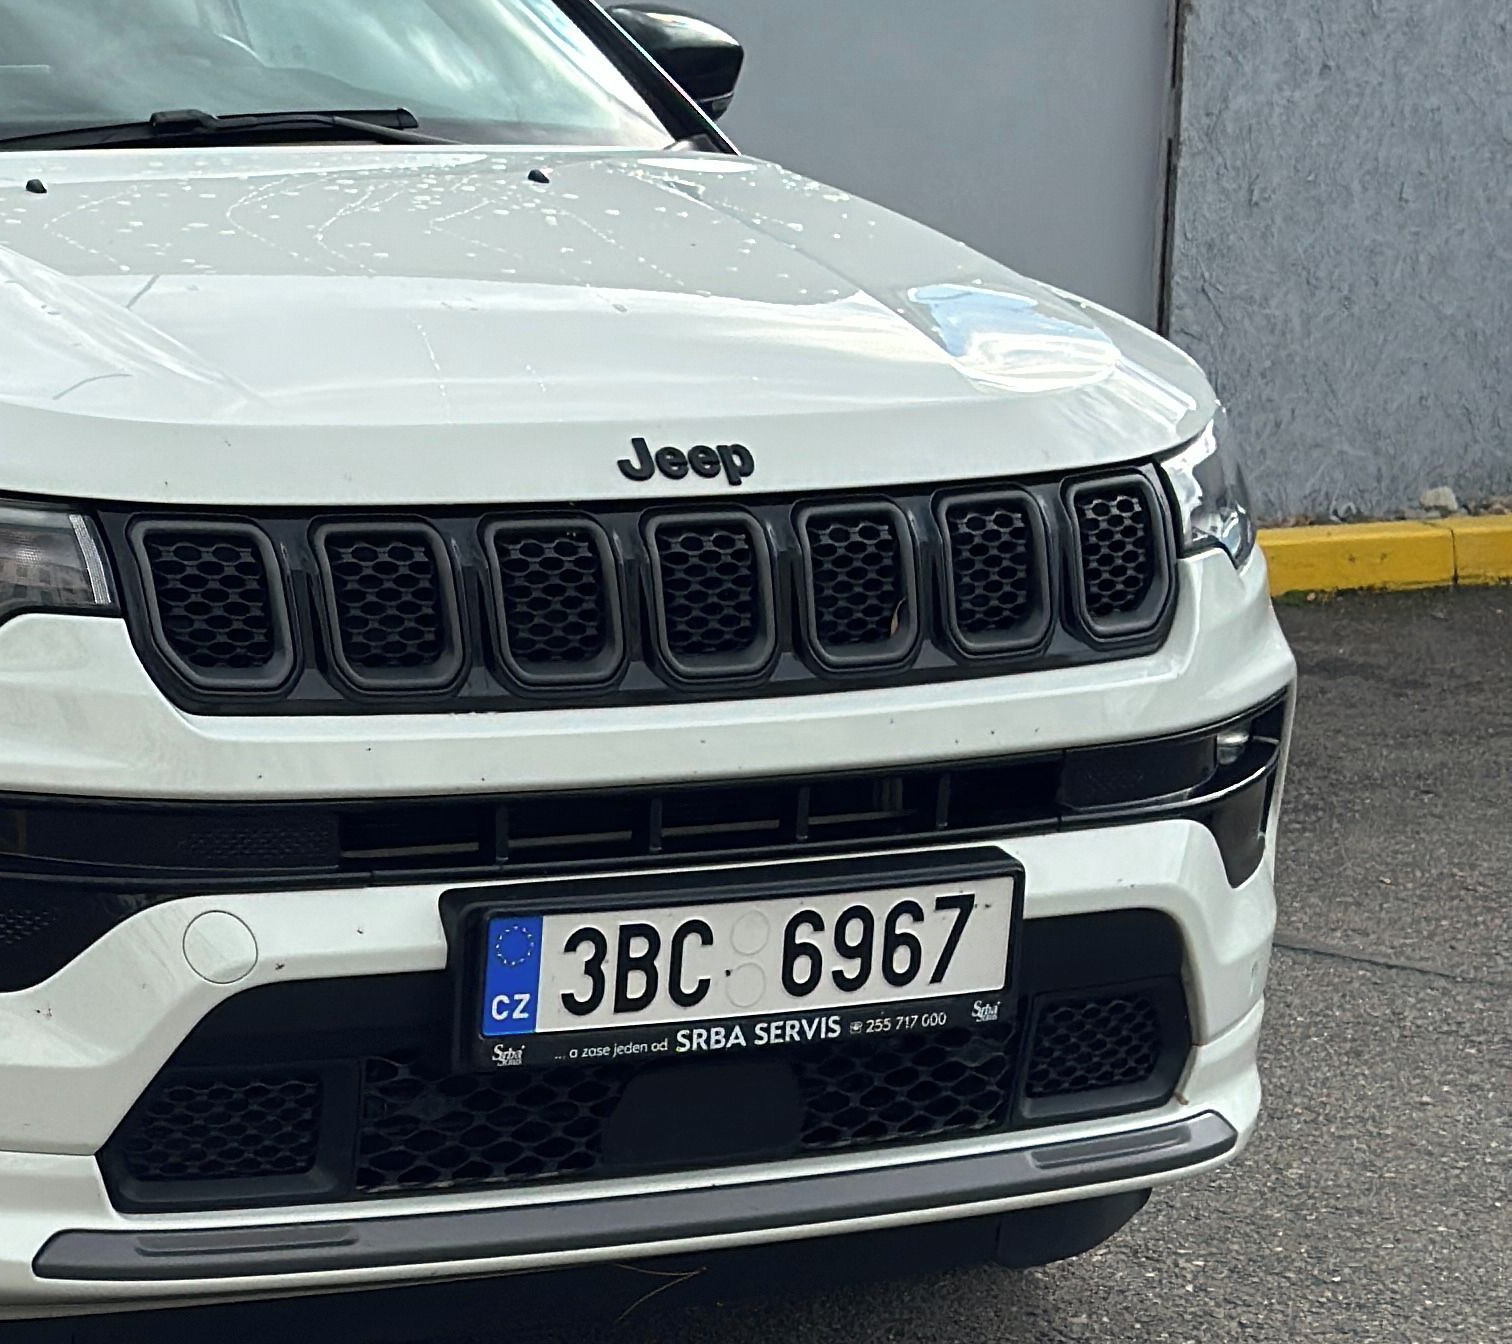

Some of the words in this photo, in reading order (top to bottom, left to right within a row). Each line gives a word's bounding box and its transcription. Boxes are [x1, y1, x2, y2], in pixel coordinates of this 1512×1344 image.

[617, 437, 755, 486] Jeep
[560, 919, 714, 1016] 3BC
[781, 894, 976, 997] 6967
[491, 993, 530, 1021] CZ
[569, 1048, 578, 1059] a
[581, 1045, 611, 1058] zase
[612, 1042, 648, 1058] jeden
[650, 1038, 668, 1052] od
[676, 1025, 747, 1053] SRBA
[754, 1015, 842, 1046] SERVIS
[865, 1018, 892, 1033] 255
[895, 1015, 919, 1030] 717
[921, 1012, 947, 1027] 000
